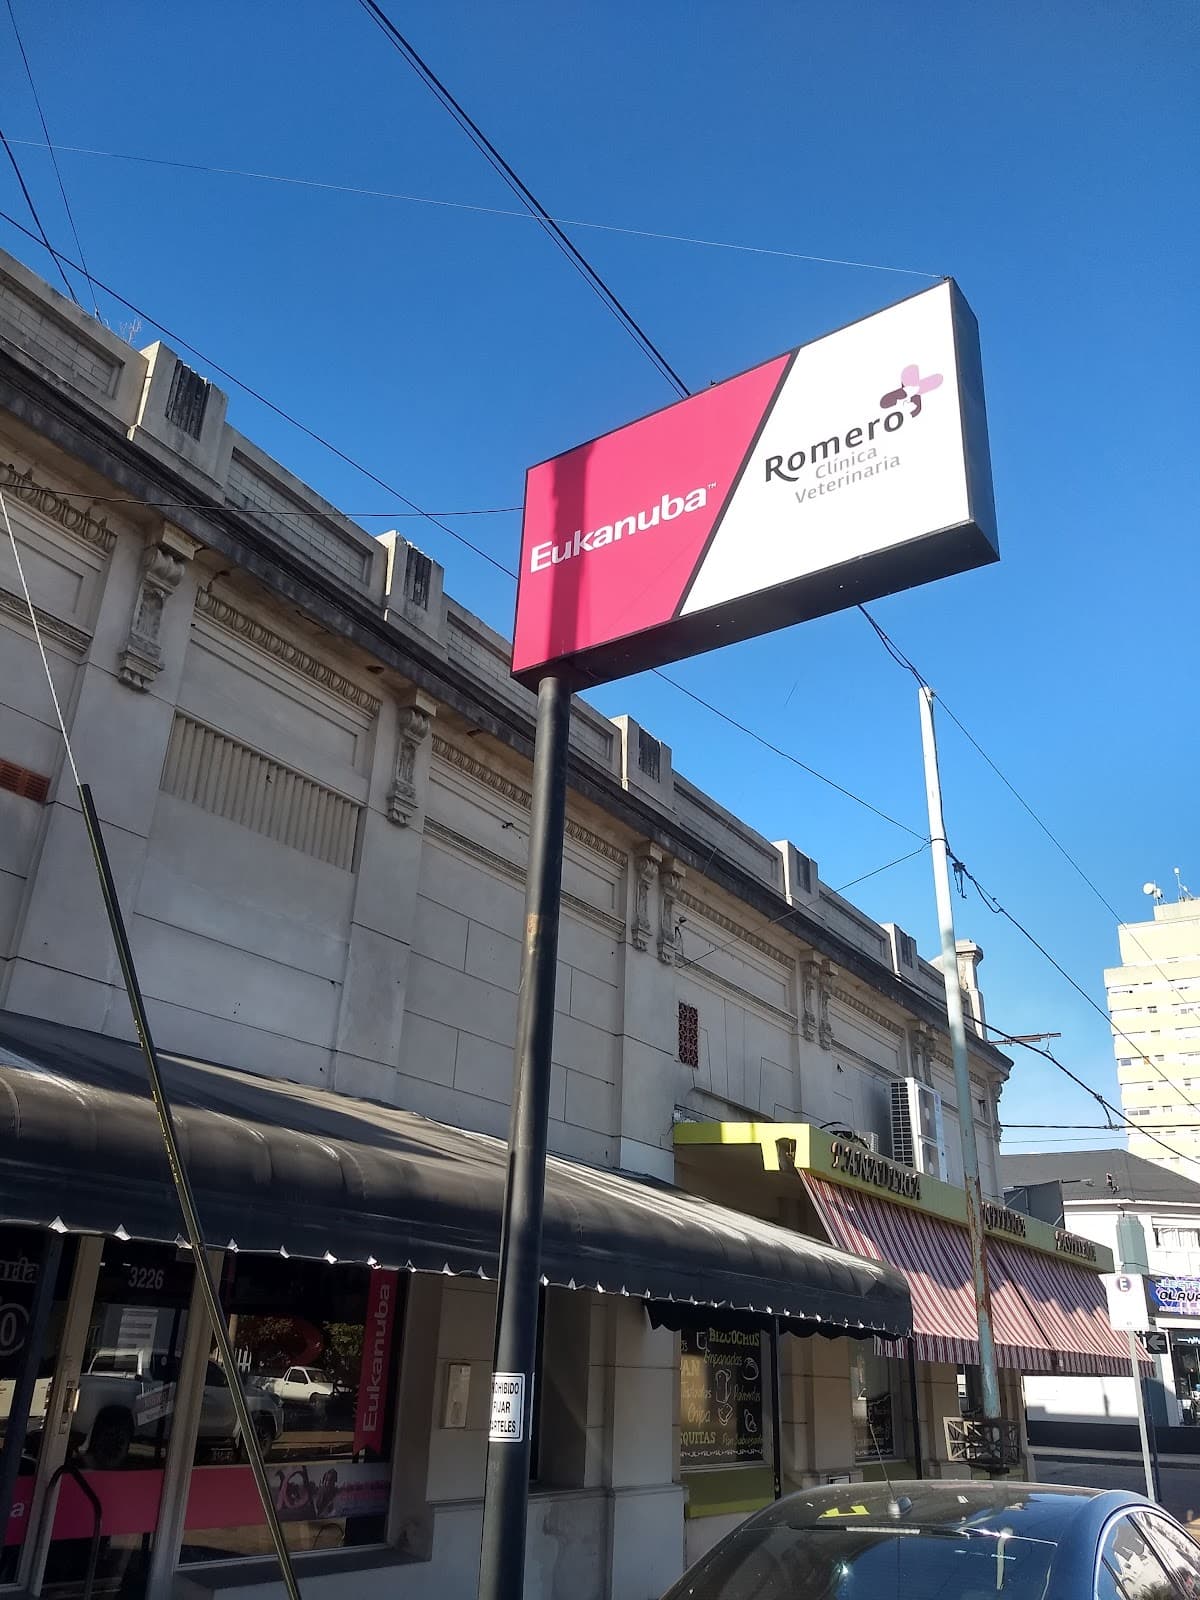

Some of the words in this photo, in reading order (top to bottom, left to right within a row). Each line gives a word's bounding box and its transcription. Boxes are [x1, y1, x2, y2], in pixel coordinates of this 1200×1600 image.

[765, 411, 904, 482] Romero
[815, 447, 878, 479] Clínica
[795, 456, 901, 504] Veterinaria
[127, 1266, 165, 1290] 3226
[1119, 1277, 1129, 1291] E
[362, 1284, 391, 1432] Eukanuba
